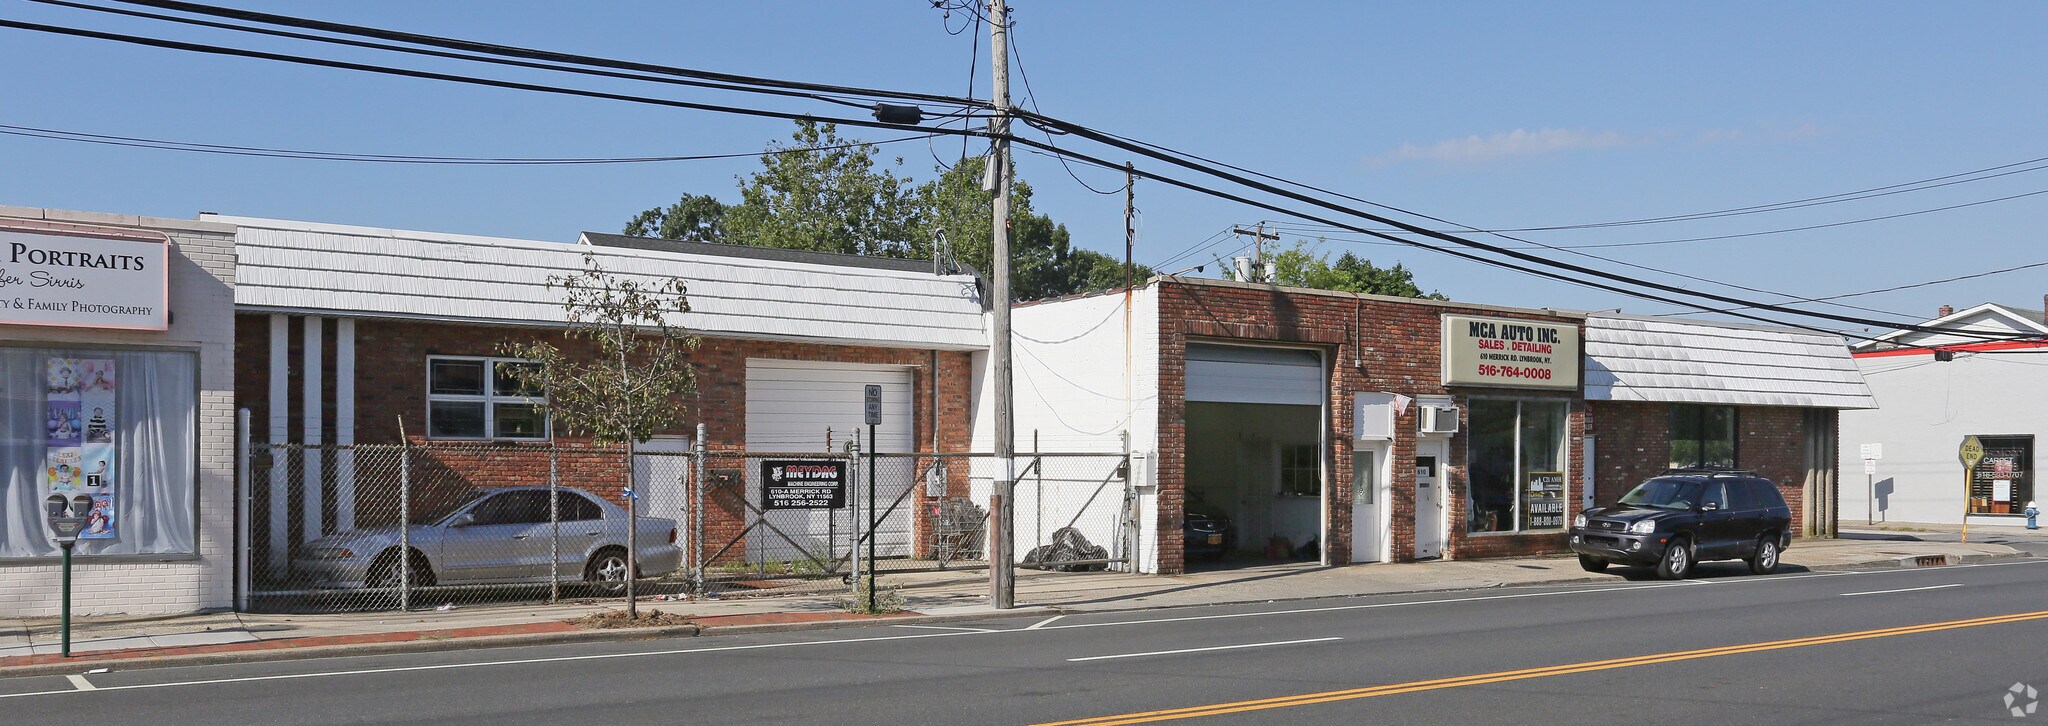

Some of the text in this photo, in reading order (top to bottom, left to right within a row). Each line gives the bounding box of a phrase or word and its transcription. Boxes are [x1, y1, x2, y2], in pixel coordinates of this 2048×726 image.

[9, 242, 144, 271] PORTRAITS
[30, 270, 85, 289] Sirris
[13, 297, 25, 309] &
[28, 298, 68, 312] FAMILY
[72, 300, 153, 316] PHOTOGRAPHY
[1469, 321, 1561, 344] MCA AUTO INC.
[1478, 338, 1505, 350] SALES
[1511, 341, 1552, 354] DETAILING
[1489, 353, 1510, 361] MERRICK
[1510, 354, 1519, 362] RD.
[1519, 355, 1544, 364] LYNBROOK,
[1478, 363, 1552, 380] 516-764-0008
[868, 388, 878, 397] NO
[1965, 445, 1979, 453] DEAD
[785, 465, 838, 479] MEYDAG
[1530, 503, 1563, 513] AVAILABLE
